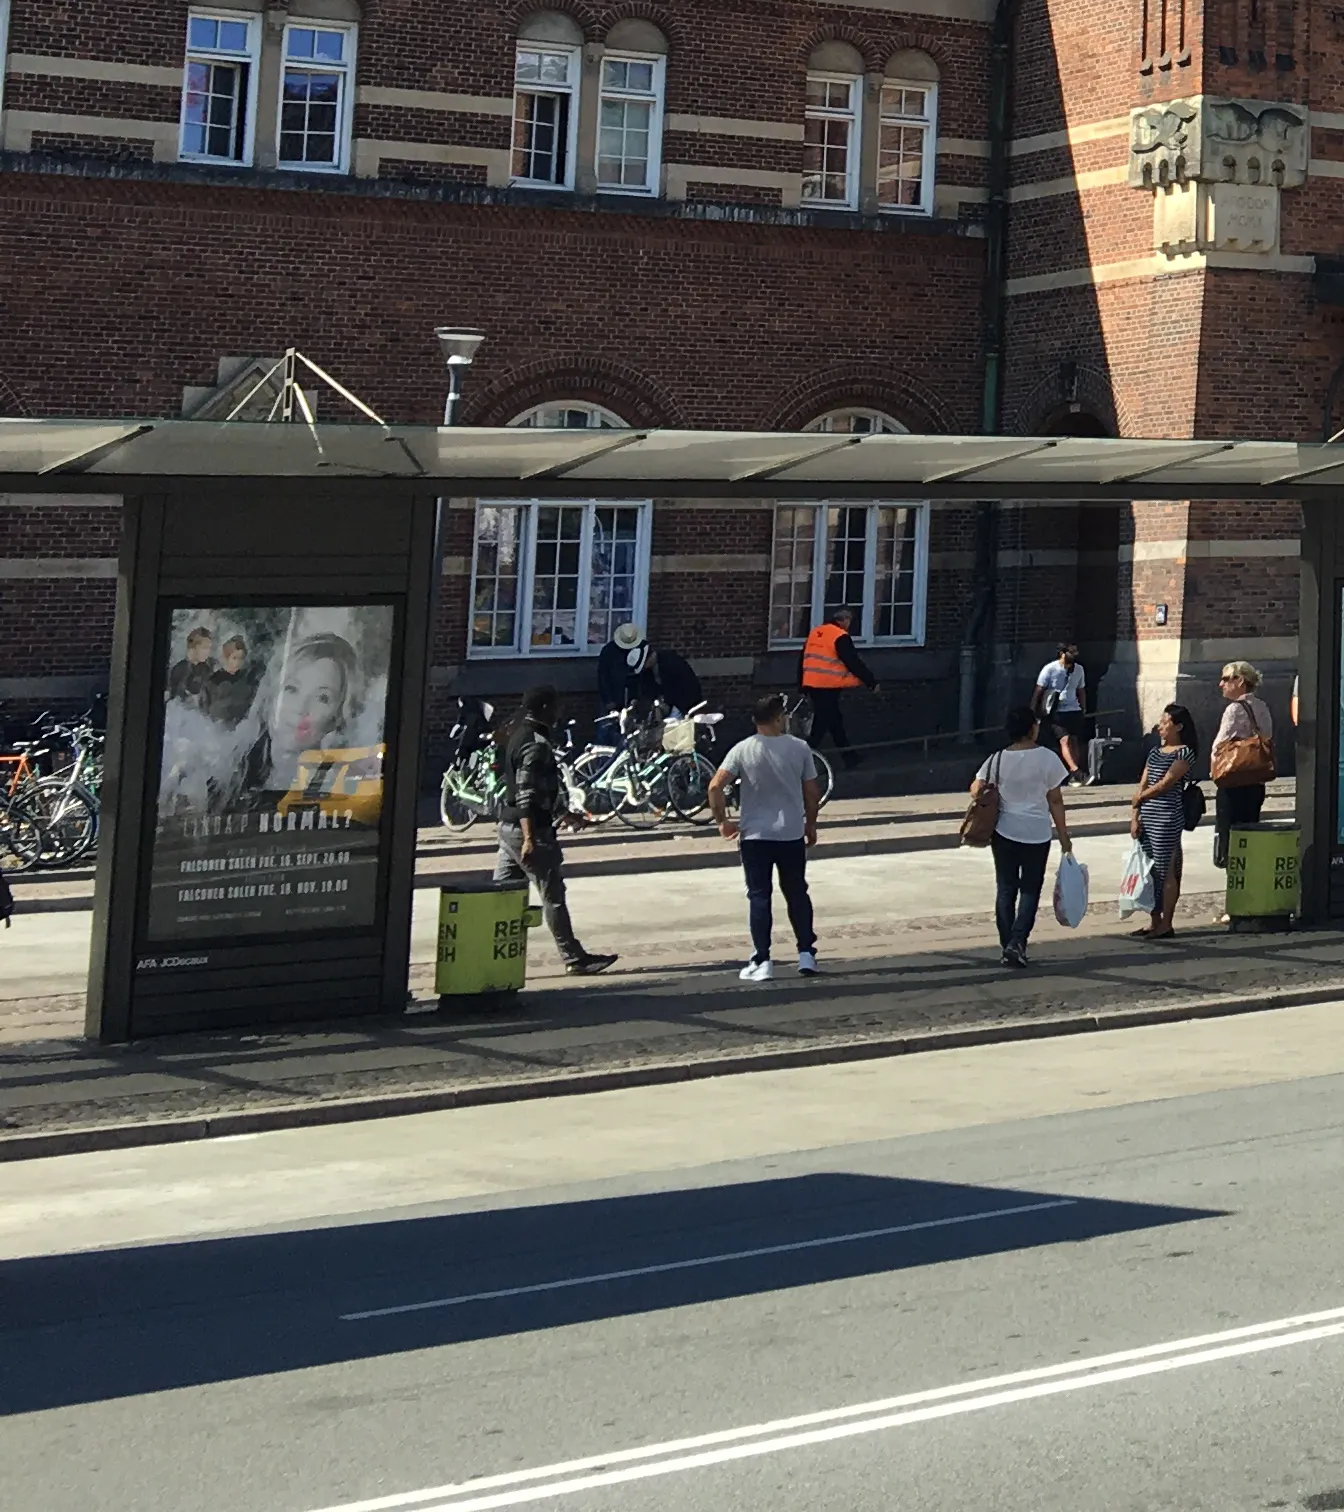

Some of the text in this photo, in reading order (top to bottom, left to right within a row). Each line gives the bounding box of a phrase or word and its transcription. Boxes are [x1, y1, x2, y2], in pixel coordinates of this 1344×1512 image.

[259, 809, 353, 833] NORMAL?
[136, 956, 209, 970] AFA JCDecaux
